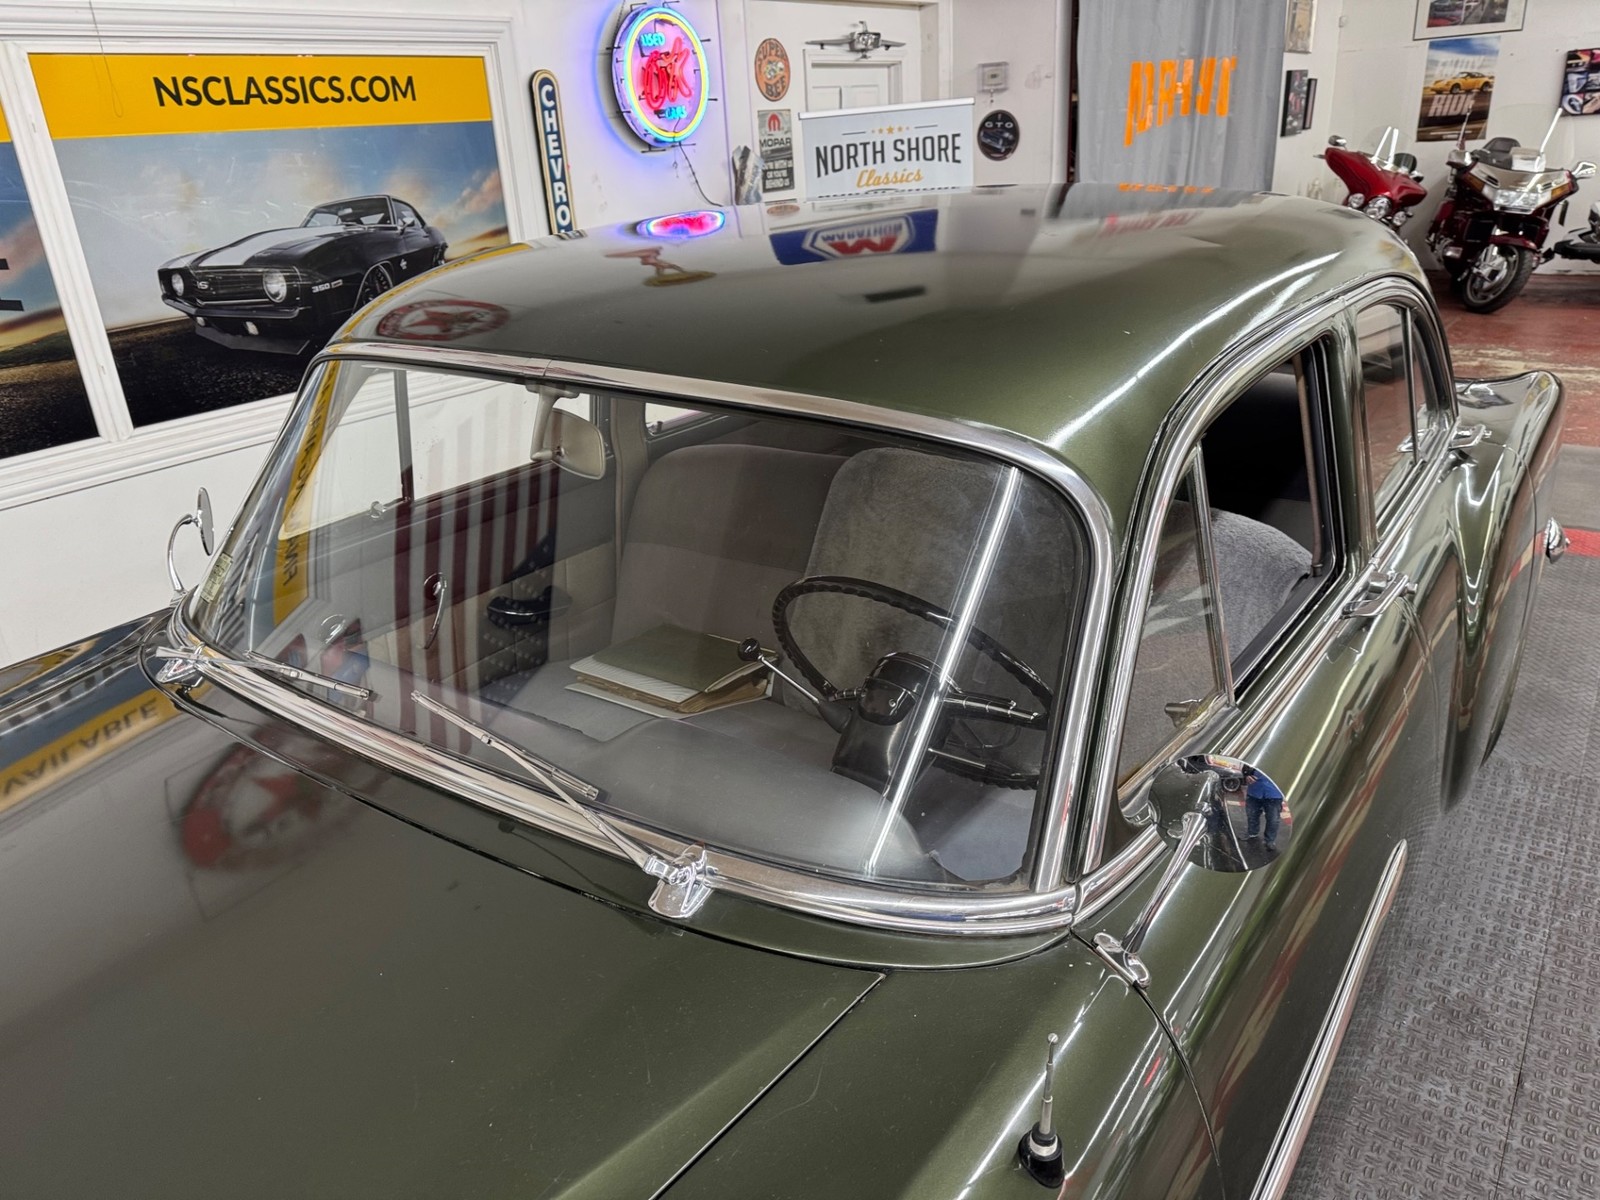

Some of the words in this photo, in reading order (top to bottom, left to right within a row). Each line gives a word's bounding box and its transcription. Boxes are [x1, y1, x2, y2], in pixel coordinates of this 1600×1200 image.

[641, 32, 666, 46] USED
[152, 75, 417, 107] NSCLASSICS.COM
[765, 76, 786, 98] BEE
[984, 121, 1014, 129] GTO
[759, 137, 793, 148] MOPAR
[540, 84, 572, 233] CHEVRO
[815, 140, 885, 178] NORTH
[893, 132, 962, 164] SHORE
[856, 167, 924, 189] Classics
